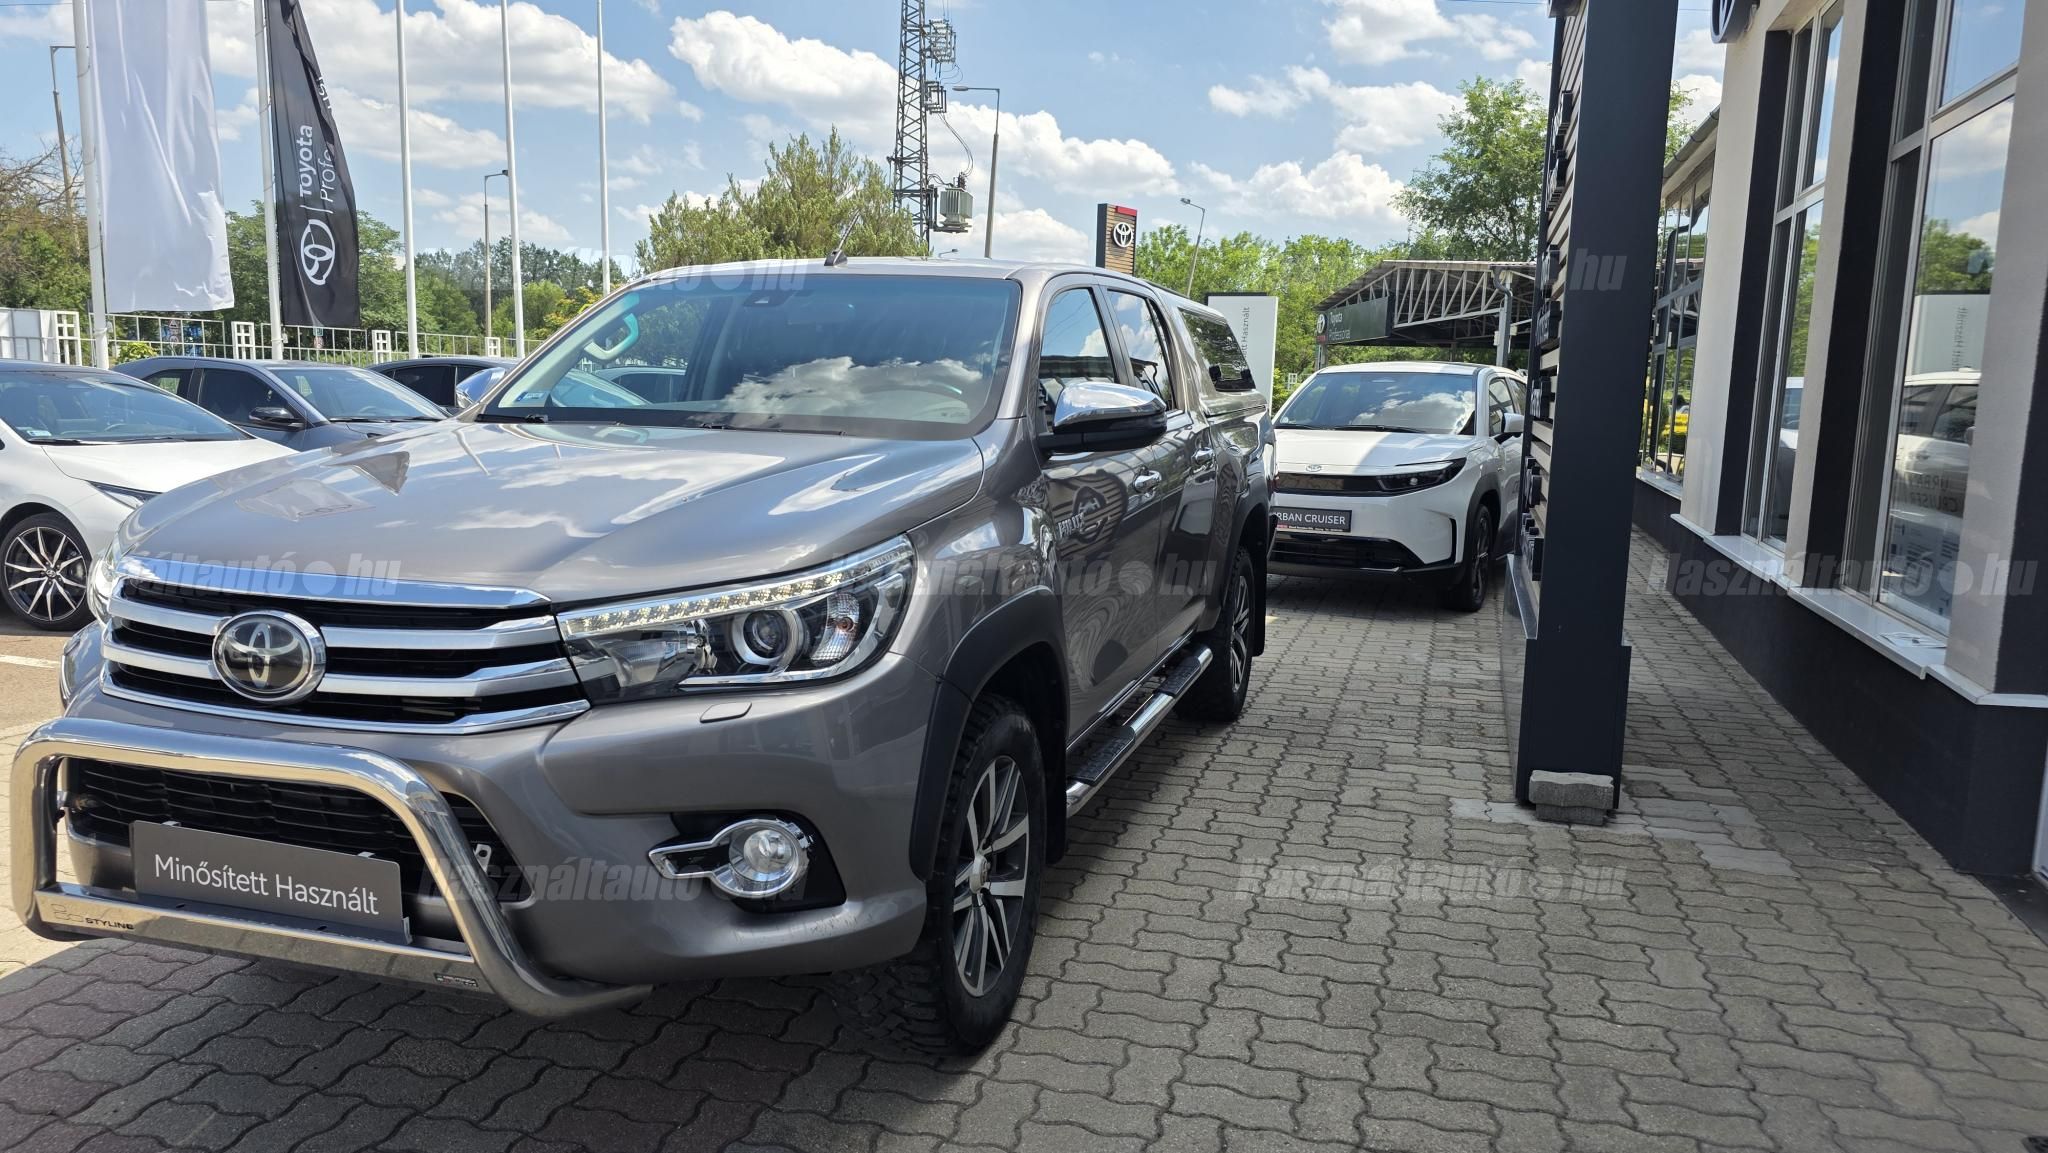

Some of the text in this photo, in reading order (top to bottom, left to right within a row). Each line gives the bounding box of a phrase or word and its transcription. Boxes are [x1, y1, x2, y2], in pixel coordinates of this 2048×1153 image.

[297, 124, 317, 198] Toyota
[1272, 512, 1346, 525] RBAN CRUISER
[154, 853, 379, 915] Minősített Használt
[85, 917, 135, 930] STYLINE
